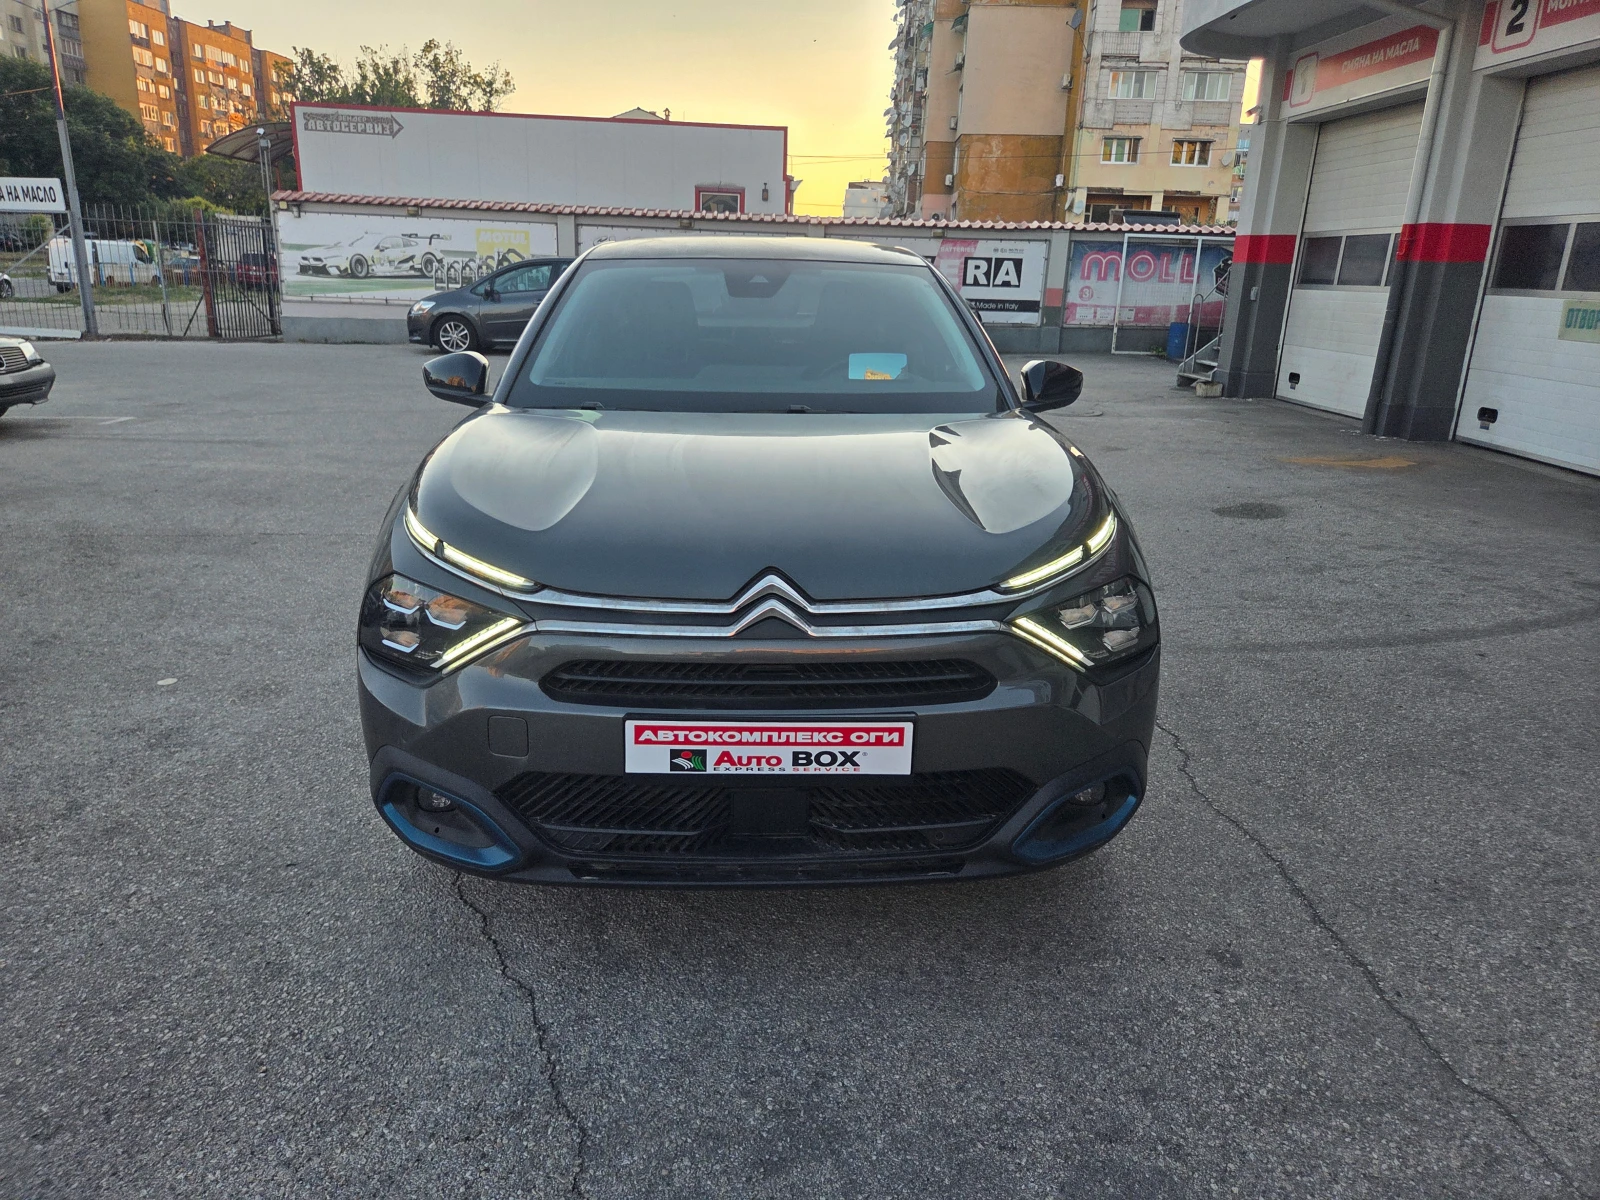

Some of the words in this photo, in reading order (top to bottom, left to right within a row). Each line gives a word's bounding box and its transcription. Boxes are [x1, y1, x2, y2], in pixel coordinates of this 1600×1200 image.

[1505, 0, 1529, 36] 2
[1372, 51, 1384, 65] НА
[1385, 37, 1420, 61] МАСЛА
[308, 120, 391, 135] АВТОСЕРВИЗ
[6, 185, 21, 202] НА
[21, 185, 57, 203] МАСЛО
[479, 231, 528, 245] MOTUL
[929, 258, 1020, 286] ERA
[977, 302, 997, 310] Made
[1005, 303, 1019, 311] Italy
[638, 730, 844, 743] АВТОКОМПЛЕКС
[850, 731, 899, 743] ОГИ
